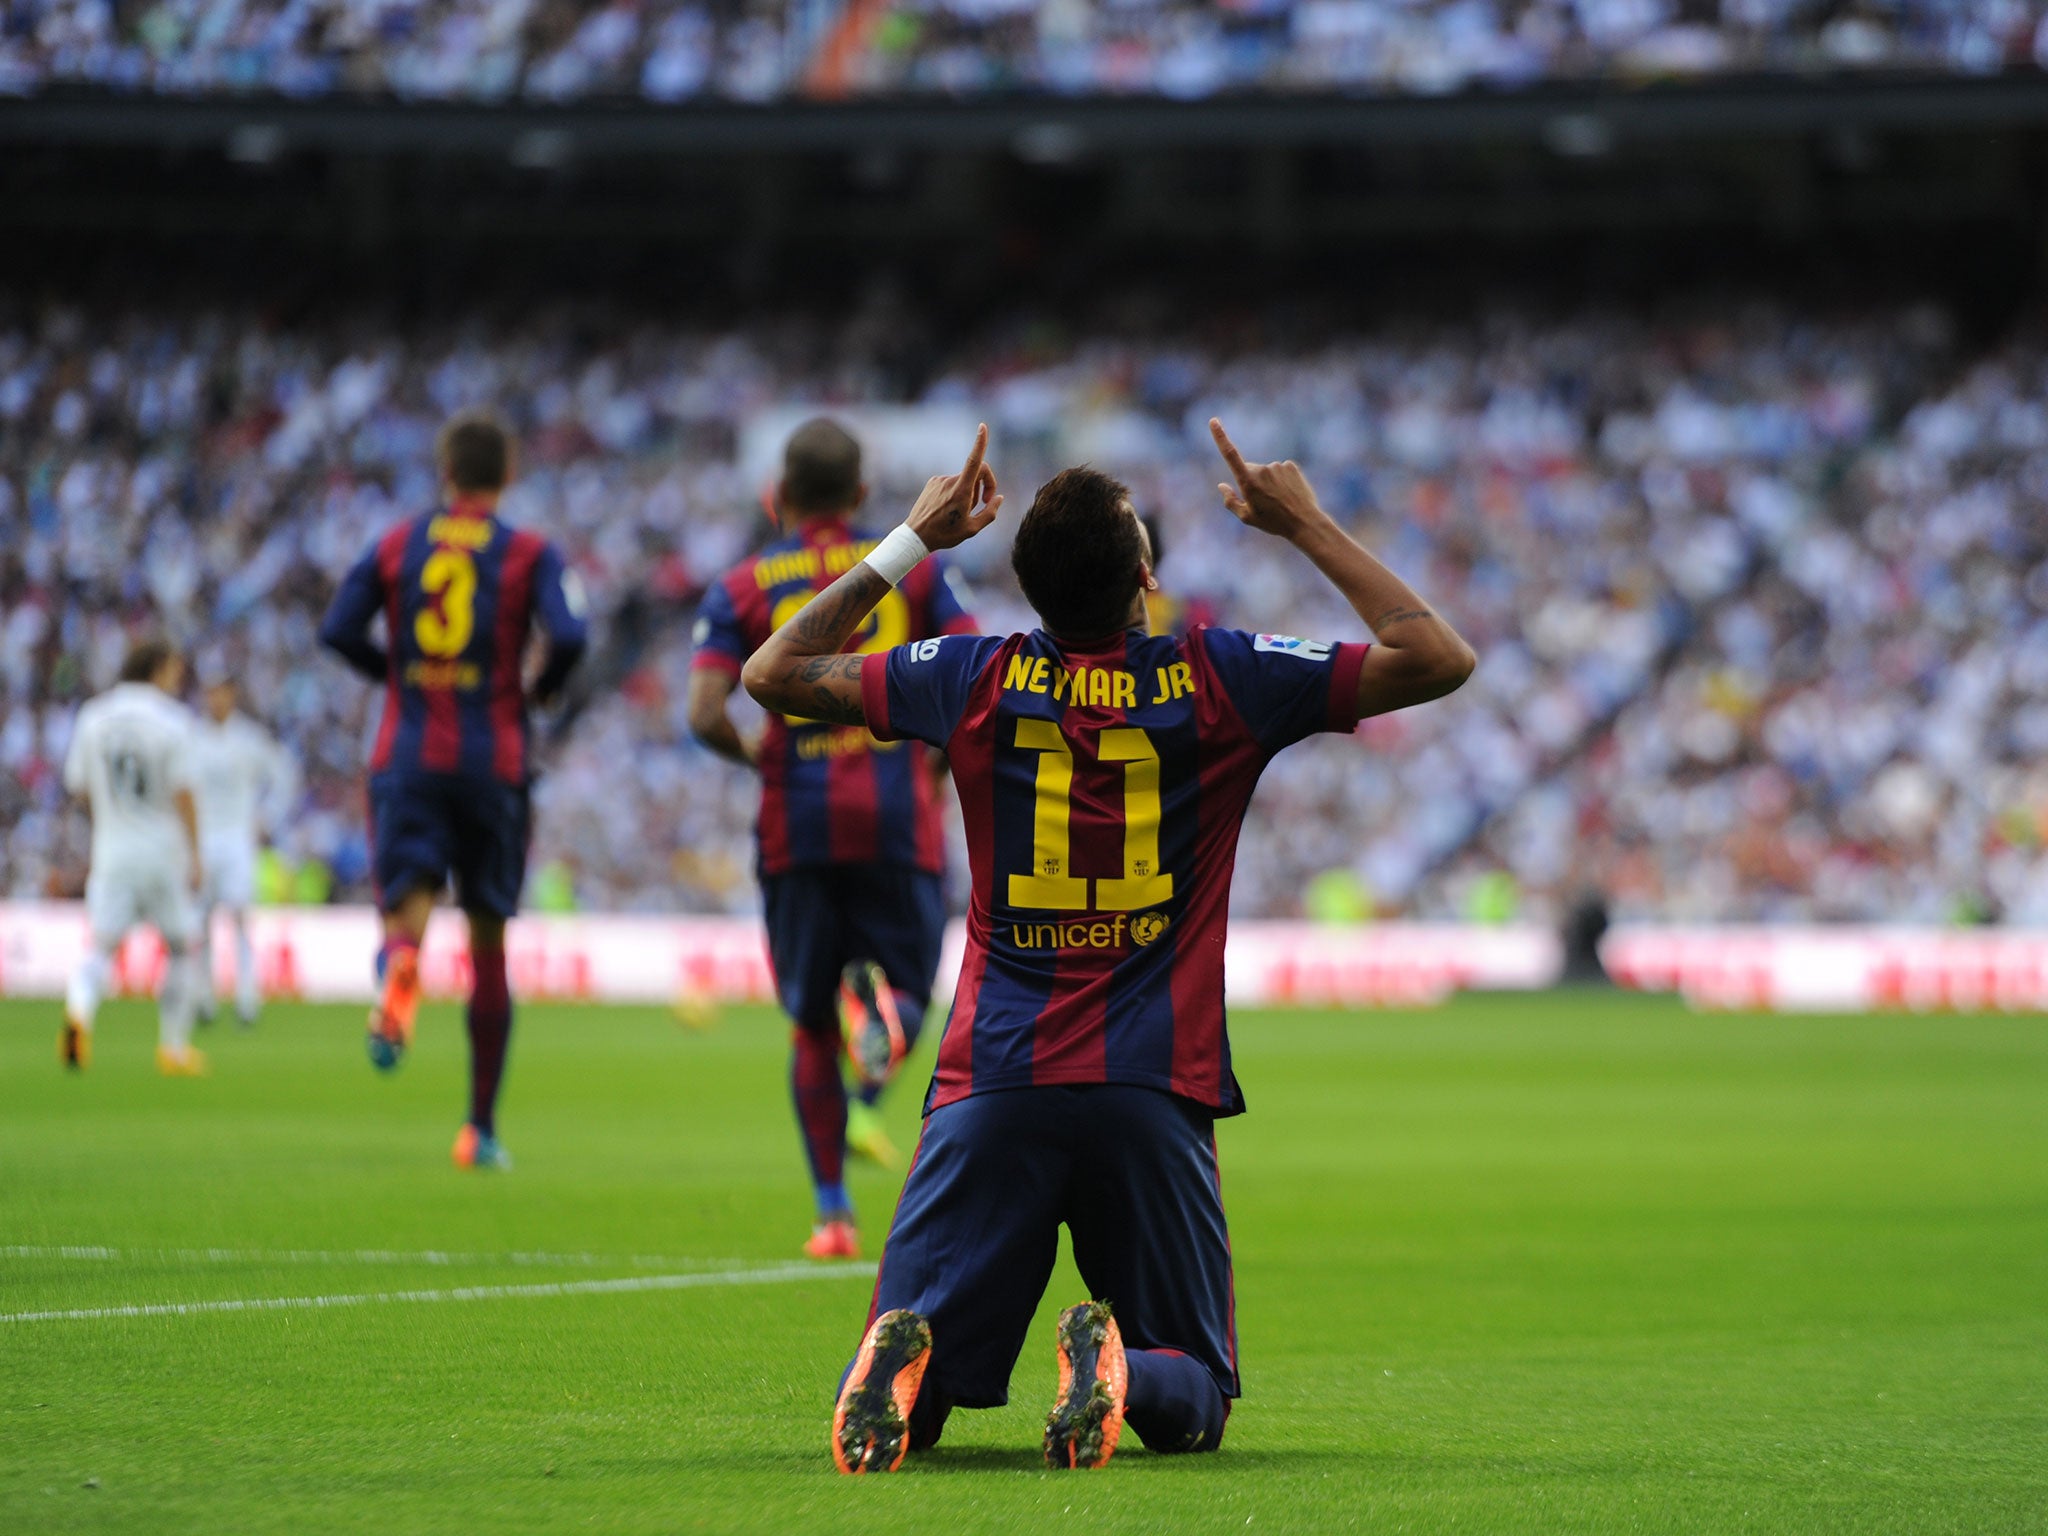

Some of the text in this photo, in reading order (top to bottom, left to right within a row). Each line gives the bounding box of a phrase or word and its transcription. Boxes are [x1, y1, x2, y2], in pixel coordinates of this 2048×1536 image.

[414, 549, 477, 659] 3
[1002, 654, 1196, 708] NEYMAR JR
[1008, 717, 1173, 911] 11
[1012, 914, 1127, 949] unicef
